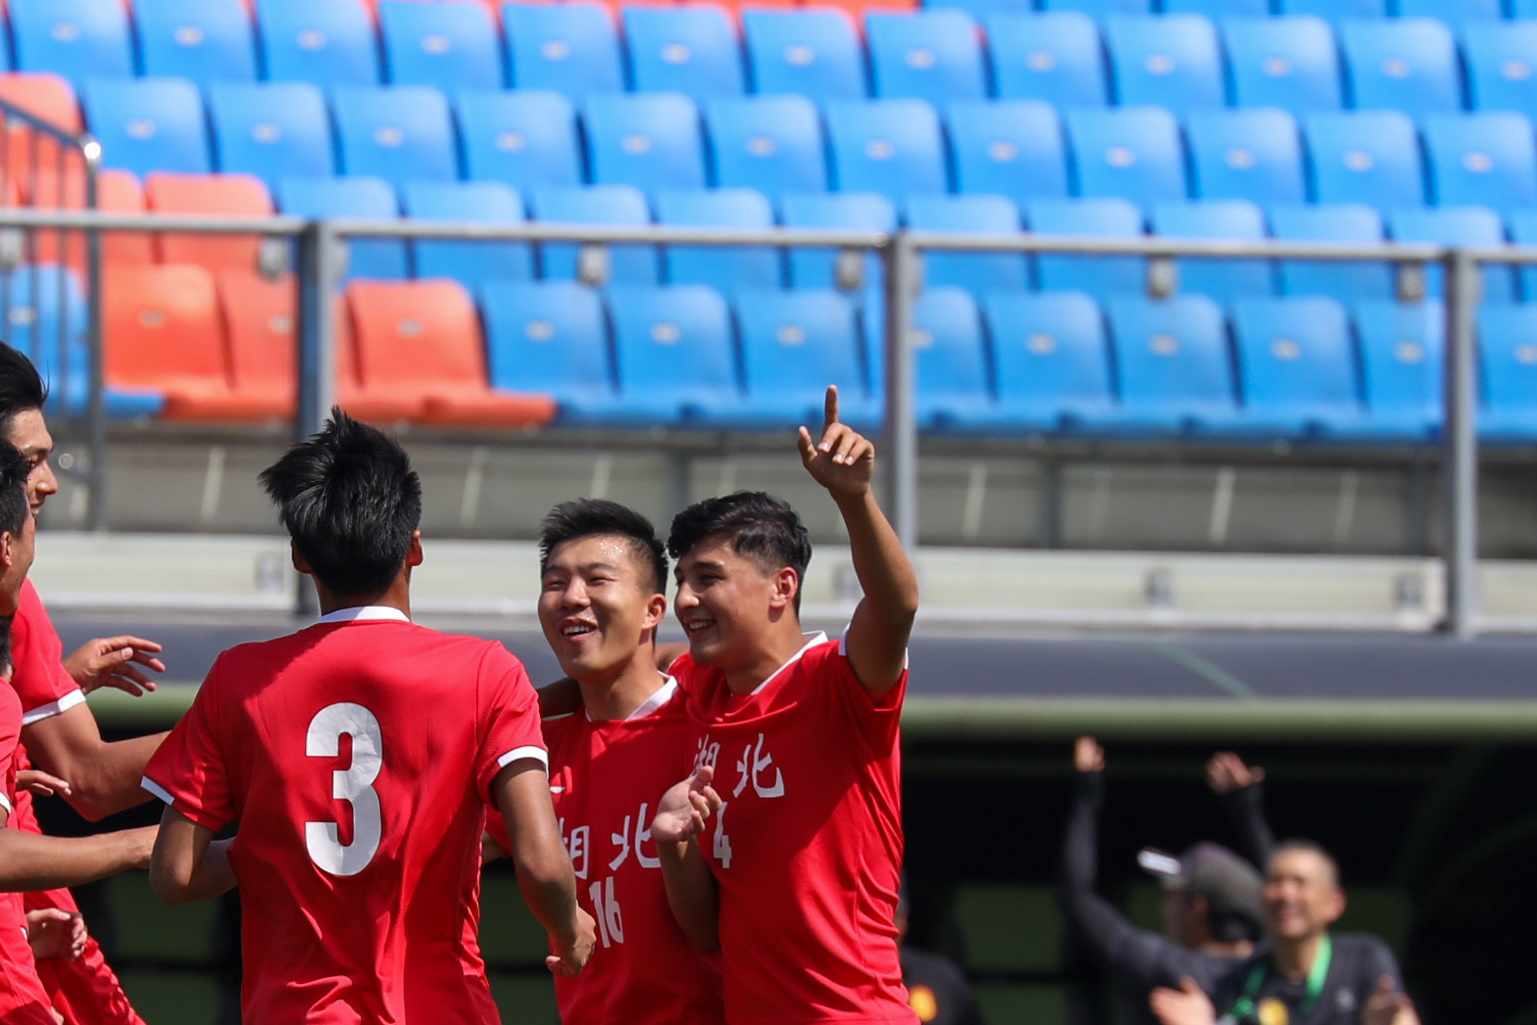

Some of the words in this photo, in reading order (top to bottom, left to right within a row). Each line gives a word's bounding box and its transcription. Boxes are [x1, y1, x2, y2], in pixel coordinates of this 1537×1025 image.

[306, 702, 383, 876] 3
[690, 733, 785, 798] 湖北
[713, 802, 732, 869] 4
[589, 876, 625, 948] 16
